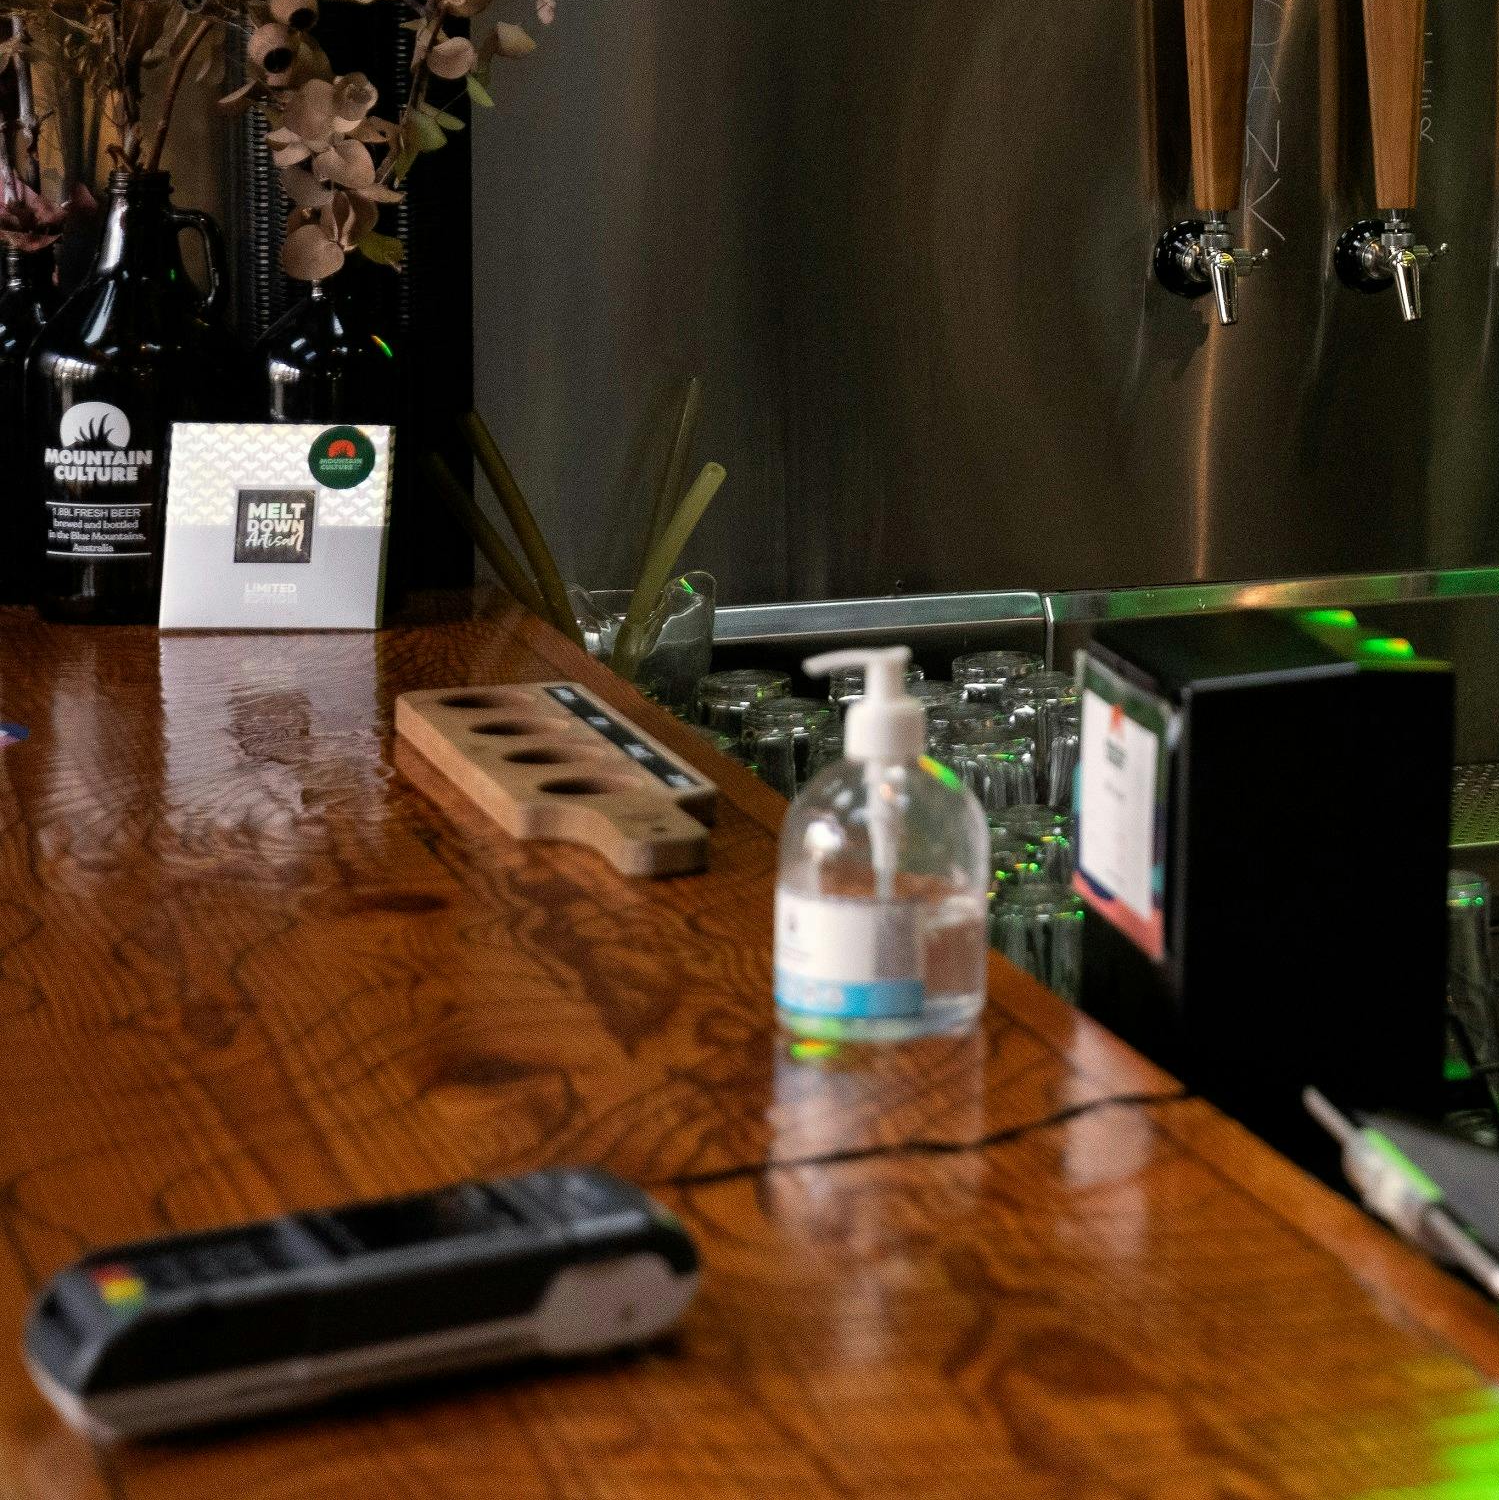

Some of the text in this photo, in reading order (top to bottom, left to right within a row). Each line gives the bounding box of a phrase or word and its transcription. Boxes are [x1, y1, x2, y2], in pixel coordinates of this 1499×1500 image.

[44, 448, 153, 466] MOUNTAIN
[54, 464, 139, 483] CULTURE
[74, 508, 109, 519] FRESH
[110, 508, 142, 519] BEER
[247, 502, 306, 519] MELT
[53, 518, 139, 529] brewed and bottled
[246, 519, 305, 533] DOWN
[70, 531, 91, 541] Blue
[245, 530, 304, 551] Artisan
[73, 543, 115, 553] Australia
[244, 582, 297, 594] LIMITED
